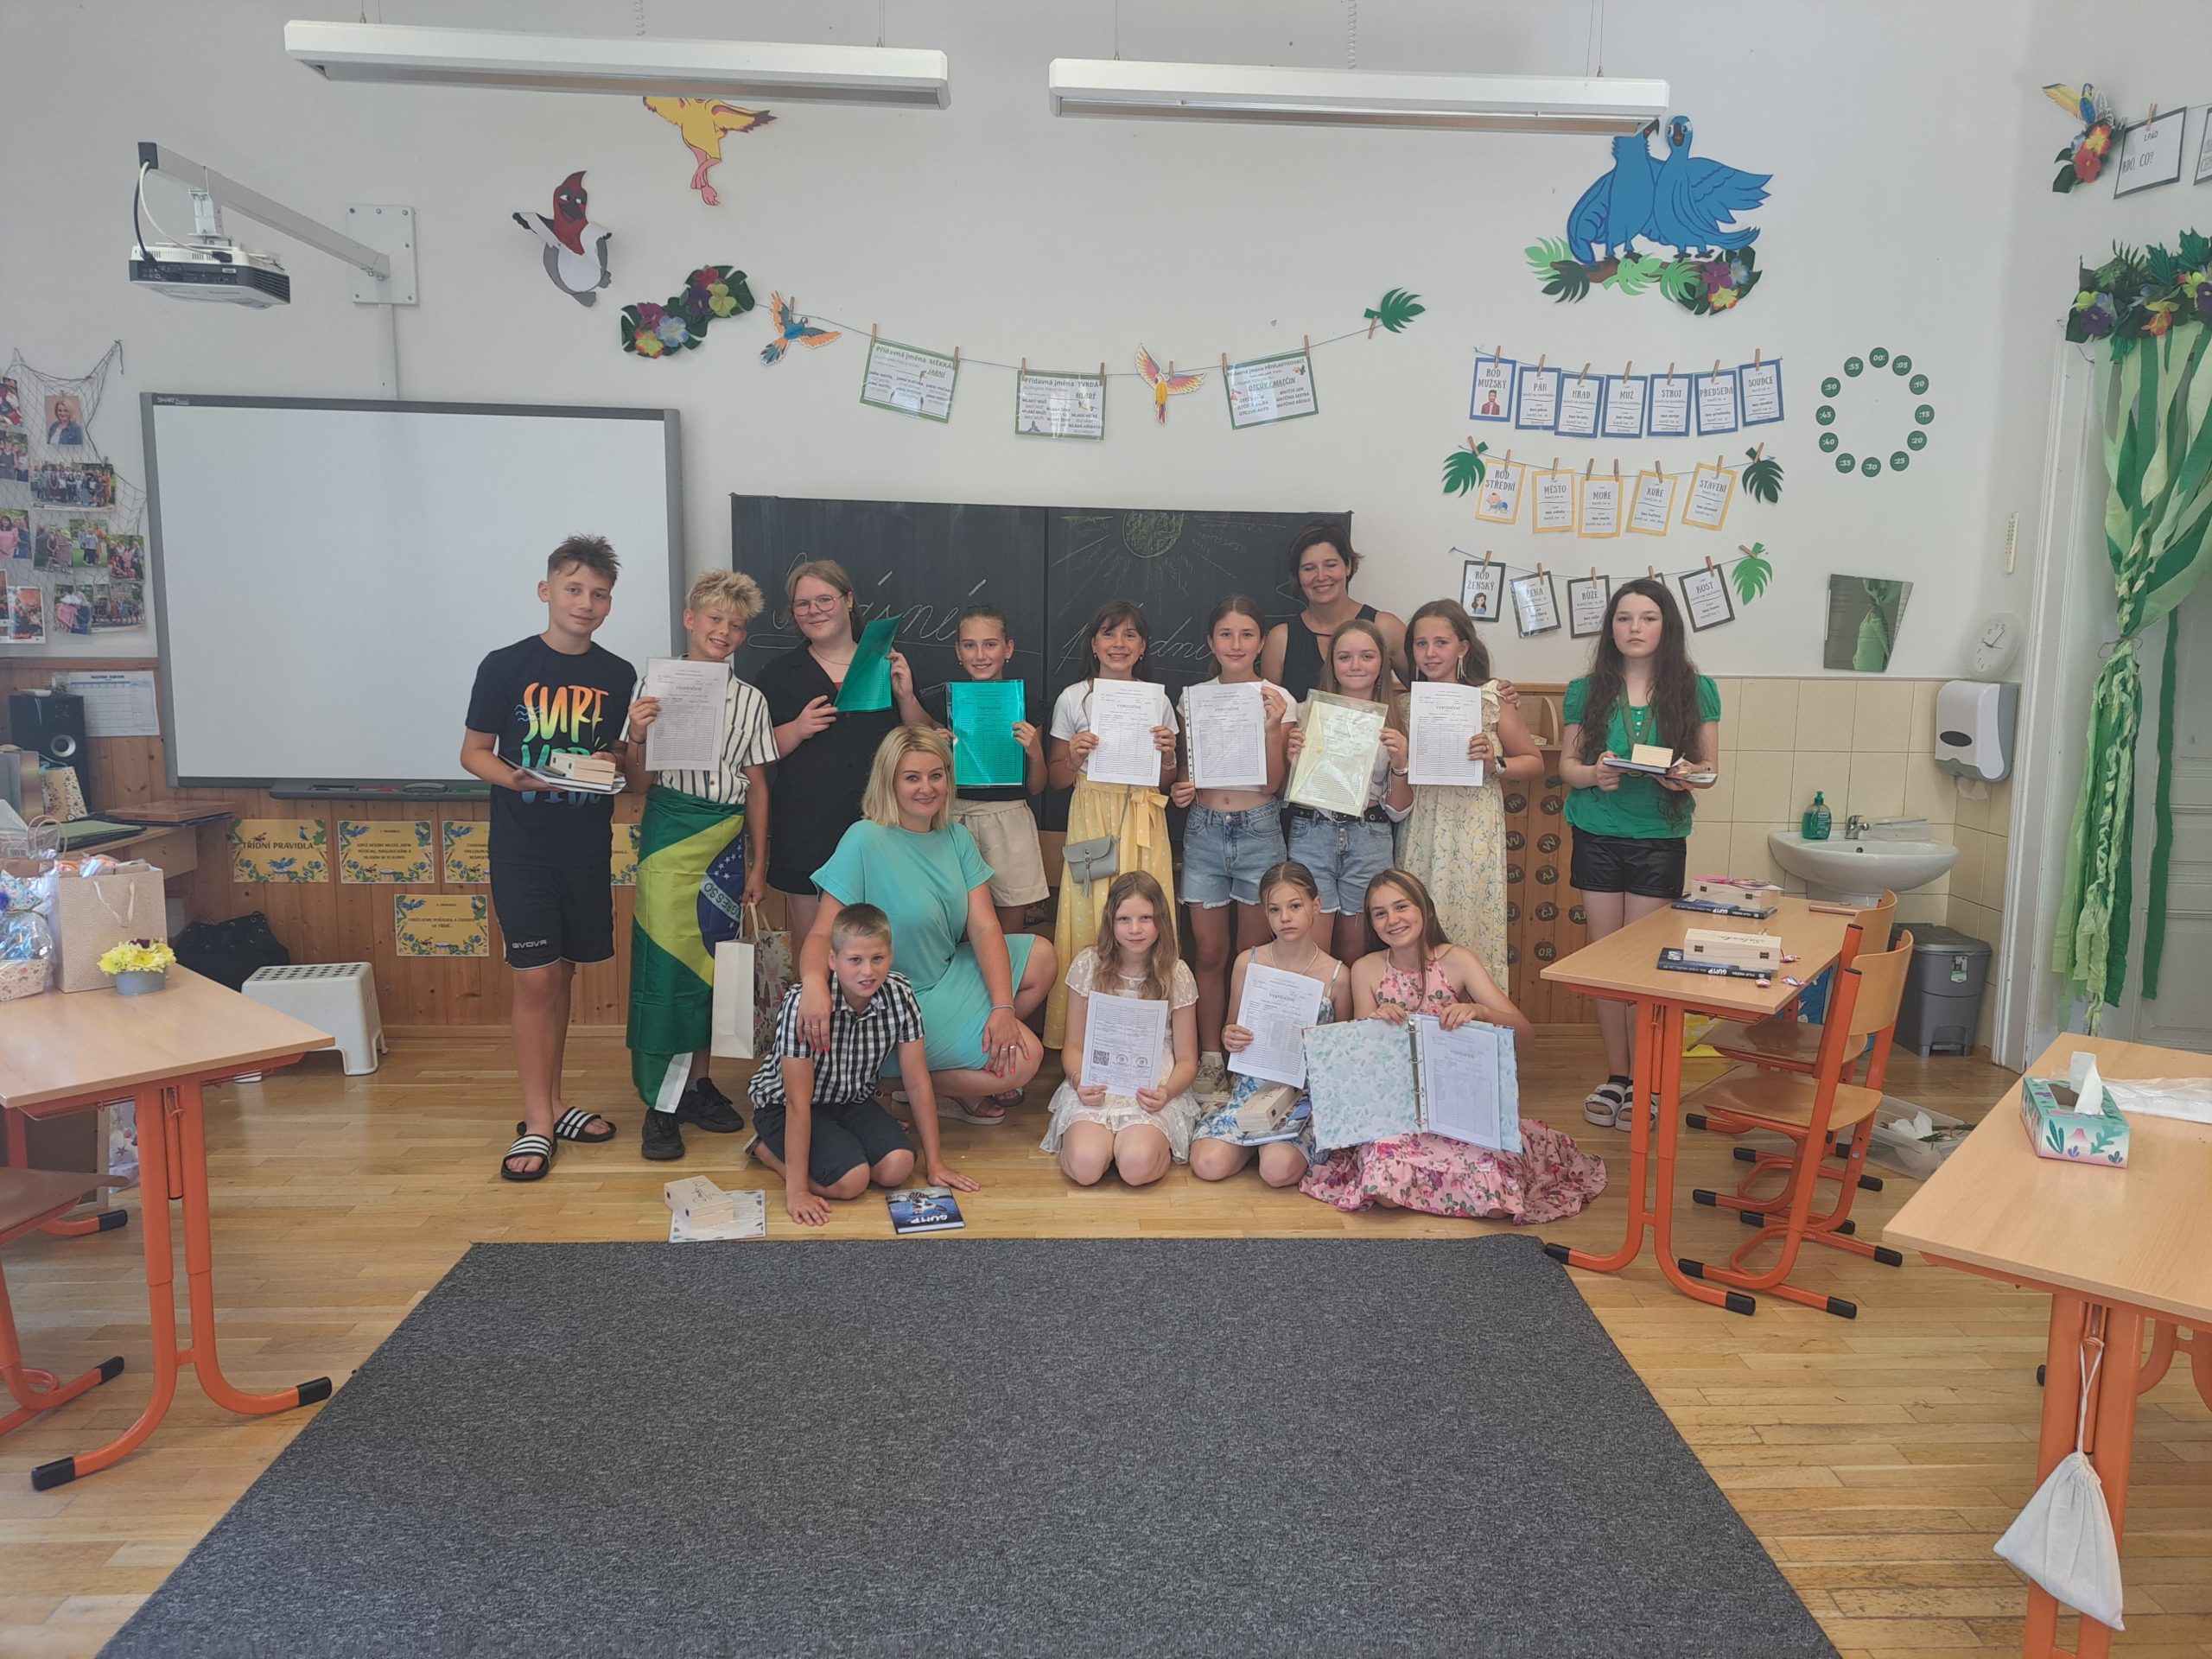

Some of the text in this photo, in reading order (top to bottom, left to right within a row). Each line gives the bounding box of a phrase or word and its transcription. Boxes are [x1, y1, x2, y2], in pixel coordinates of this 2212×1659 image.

[876, 346, 905, 358] Přídavná
[906, 353, 926, 363] jména
[929, 358, 952, 369] MĚKKÁ
[1486, 368, 1501, 378] ROD
[1025, 377, 1052, 385] Přídavná
[1273, 377, 1296, 385] MATČIN
[1478, 378, 1508, 390] MUŽSKÝ
[1748, 376, 1773, 387] SOUDCE
[1533, 382, 1548, 391] PÁN
[1700, 386, 1733, 397] PŘEDSEDA
[1572, 390, 1591, 399] HRAD
[1620, 390, 1634, 399] MUŽ
[1661, 389, 1682, 398] STROJ
[1495, 470, 1510, 480] ROD
[1485, 480, 1516, 491] STŘEDNÍ
[1544, 484, 1567, 494] MĚSTO
[1700, 480, 1728, 493] STAVENÍ
[1592, 491, 1611, 500] MOŘE
[1647, 487, 1664, 498] KUŘE
[1475, 571, 1491, 580] ROD
[1467, 581, 1495, 591] ŽENSKÝ
[1696, 582, 1714, 594] KOST
[1526, 588, 1543, 599] ŽENA
[1581, 590, 1599, 601] RŮŽE
[523, 681, 609, 743] SURF
[242, 841, 271, 849] TŘÍDNÍ
[910, 1214, 948, 1224] GUMP
